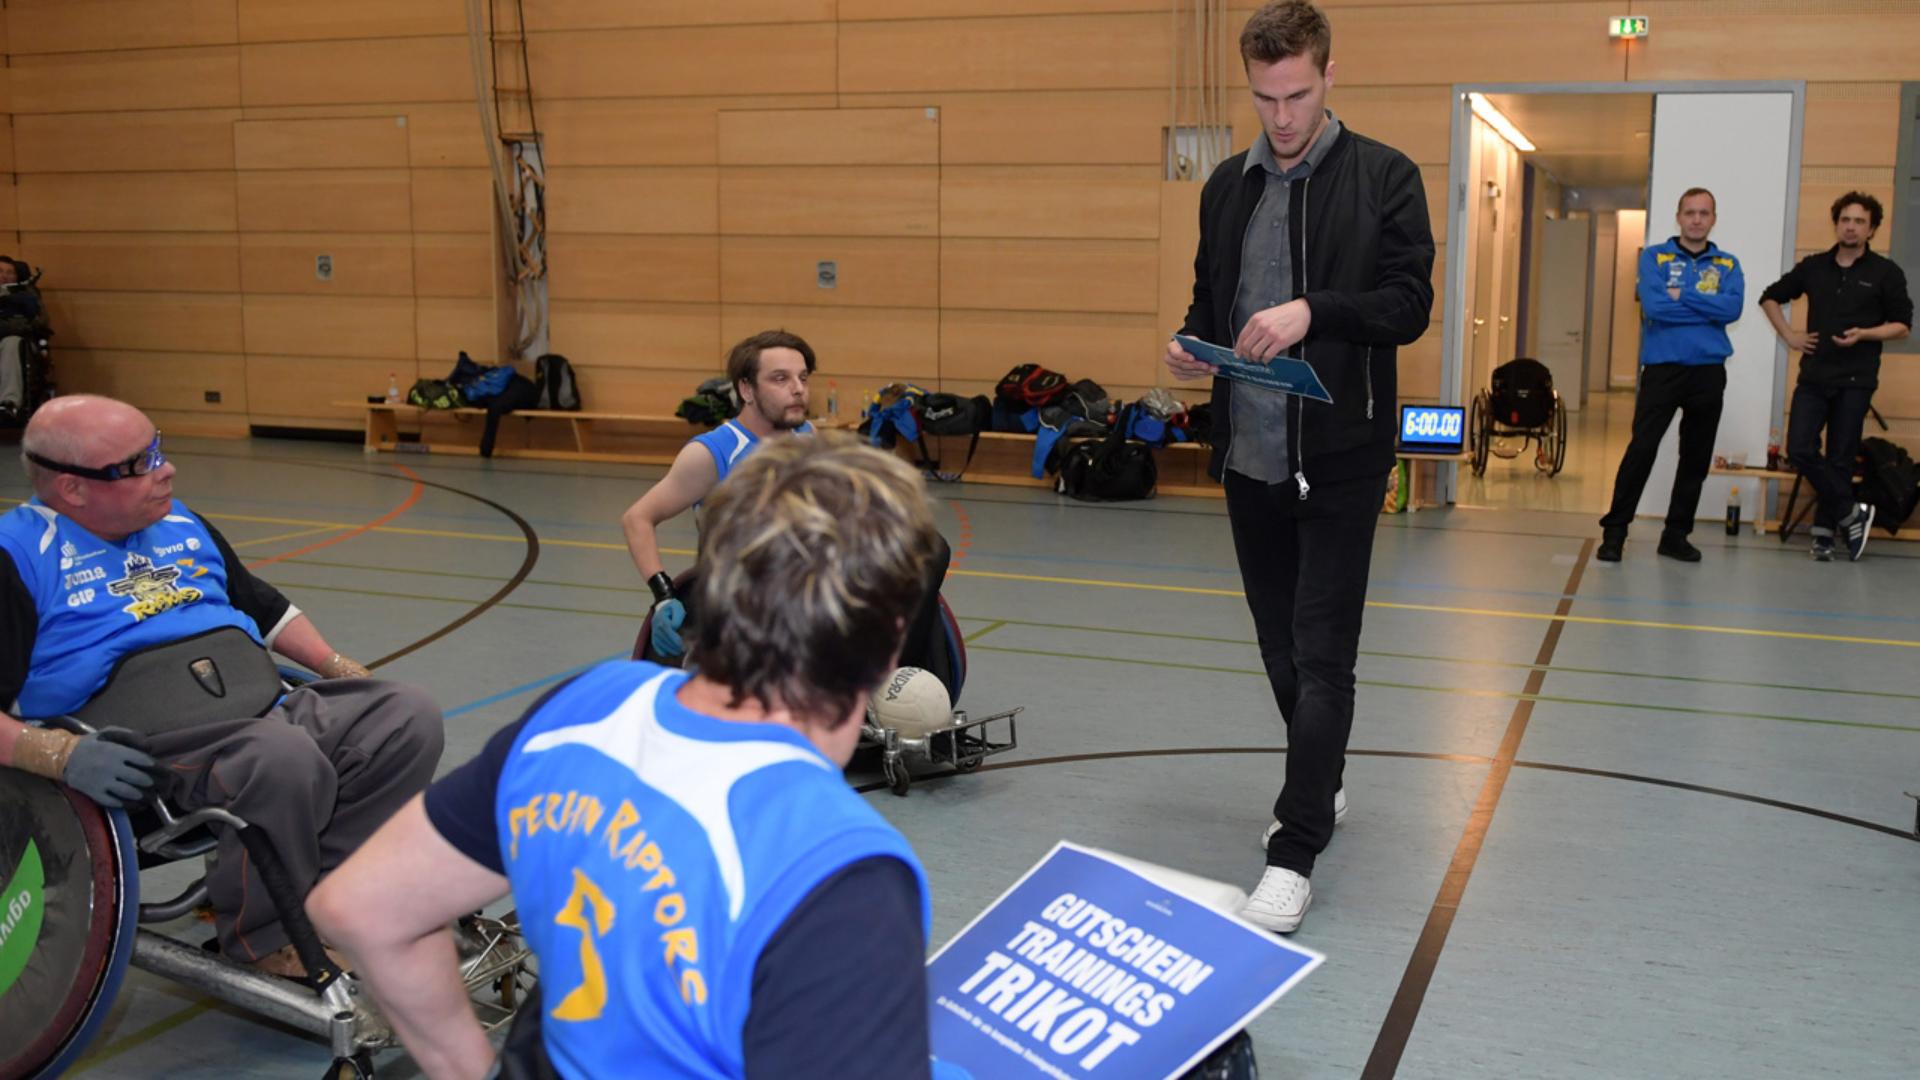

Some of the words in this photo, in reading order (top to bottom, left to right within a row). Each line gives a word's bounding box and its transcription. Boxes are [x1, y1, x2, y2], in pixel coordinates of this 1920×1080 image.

[1405, 411, 1461, 437] 6:00.00
[1005, 921, 1176, 1028] TRAININGS
[1040, 893, 1215, 995] GUTSCHEIN
[958, 951, 1142, 1071] TRIKOT
